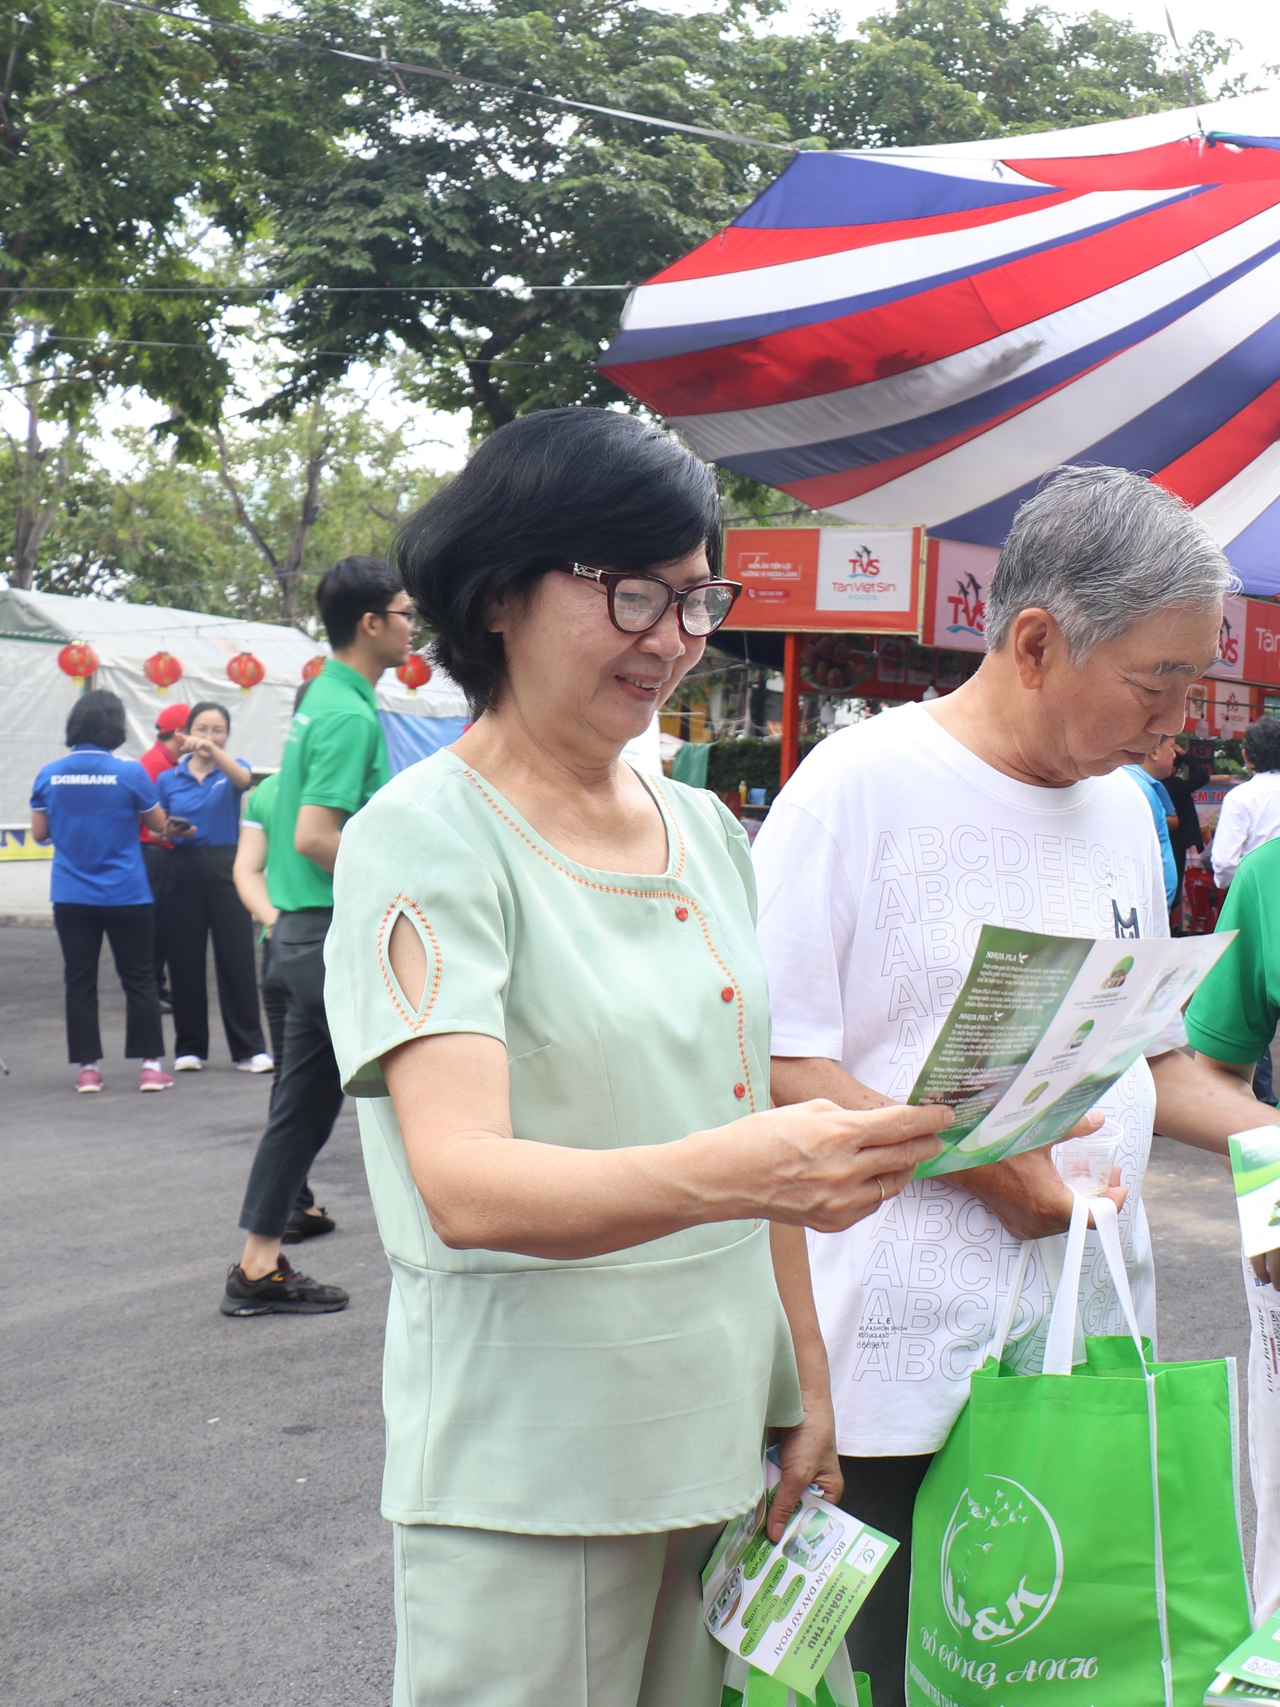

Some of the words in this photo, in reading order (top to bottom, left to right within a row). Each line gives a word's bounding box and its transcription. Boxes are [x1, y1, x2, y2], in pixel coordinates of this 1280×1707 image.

[848, 558, 880, 576] TVS
[50, 774, 118, 786] EXIMBANK
[986, 951, 1004, 962] NHỰA
[1004, 952, 1017, 962] PLA
[959, 1012, 977, 1022] NHỰA
[827, 1539, 846, 1563] BỘT
[814, 1562, 834, 1587] SẮN
[852, 1574, 867, 1594] CÔNG
[781, 1586, 796, 1606] sung
[799, 1585, 819, 1610] DÂY
[824, 1584, 849, 1618] HOÀNG
[846, 1594, 855, 1604] TY
[789, 1609, 804, 1627] XỨ
[834, 1603, 849, 1624] THỰC
[773, 1627, 794, 1656] ĐOÀI
[806, 1625, 824, 1649] THU
[822, 1624, 839, 1648] PHẨM
[809, 1647, 824, 1669] XANH
[1005, 1656, 1099, 1683] ANH
